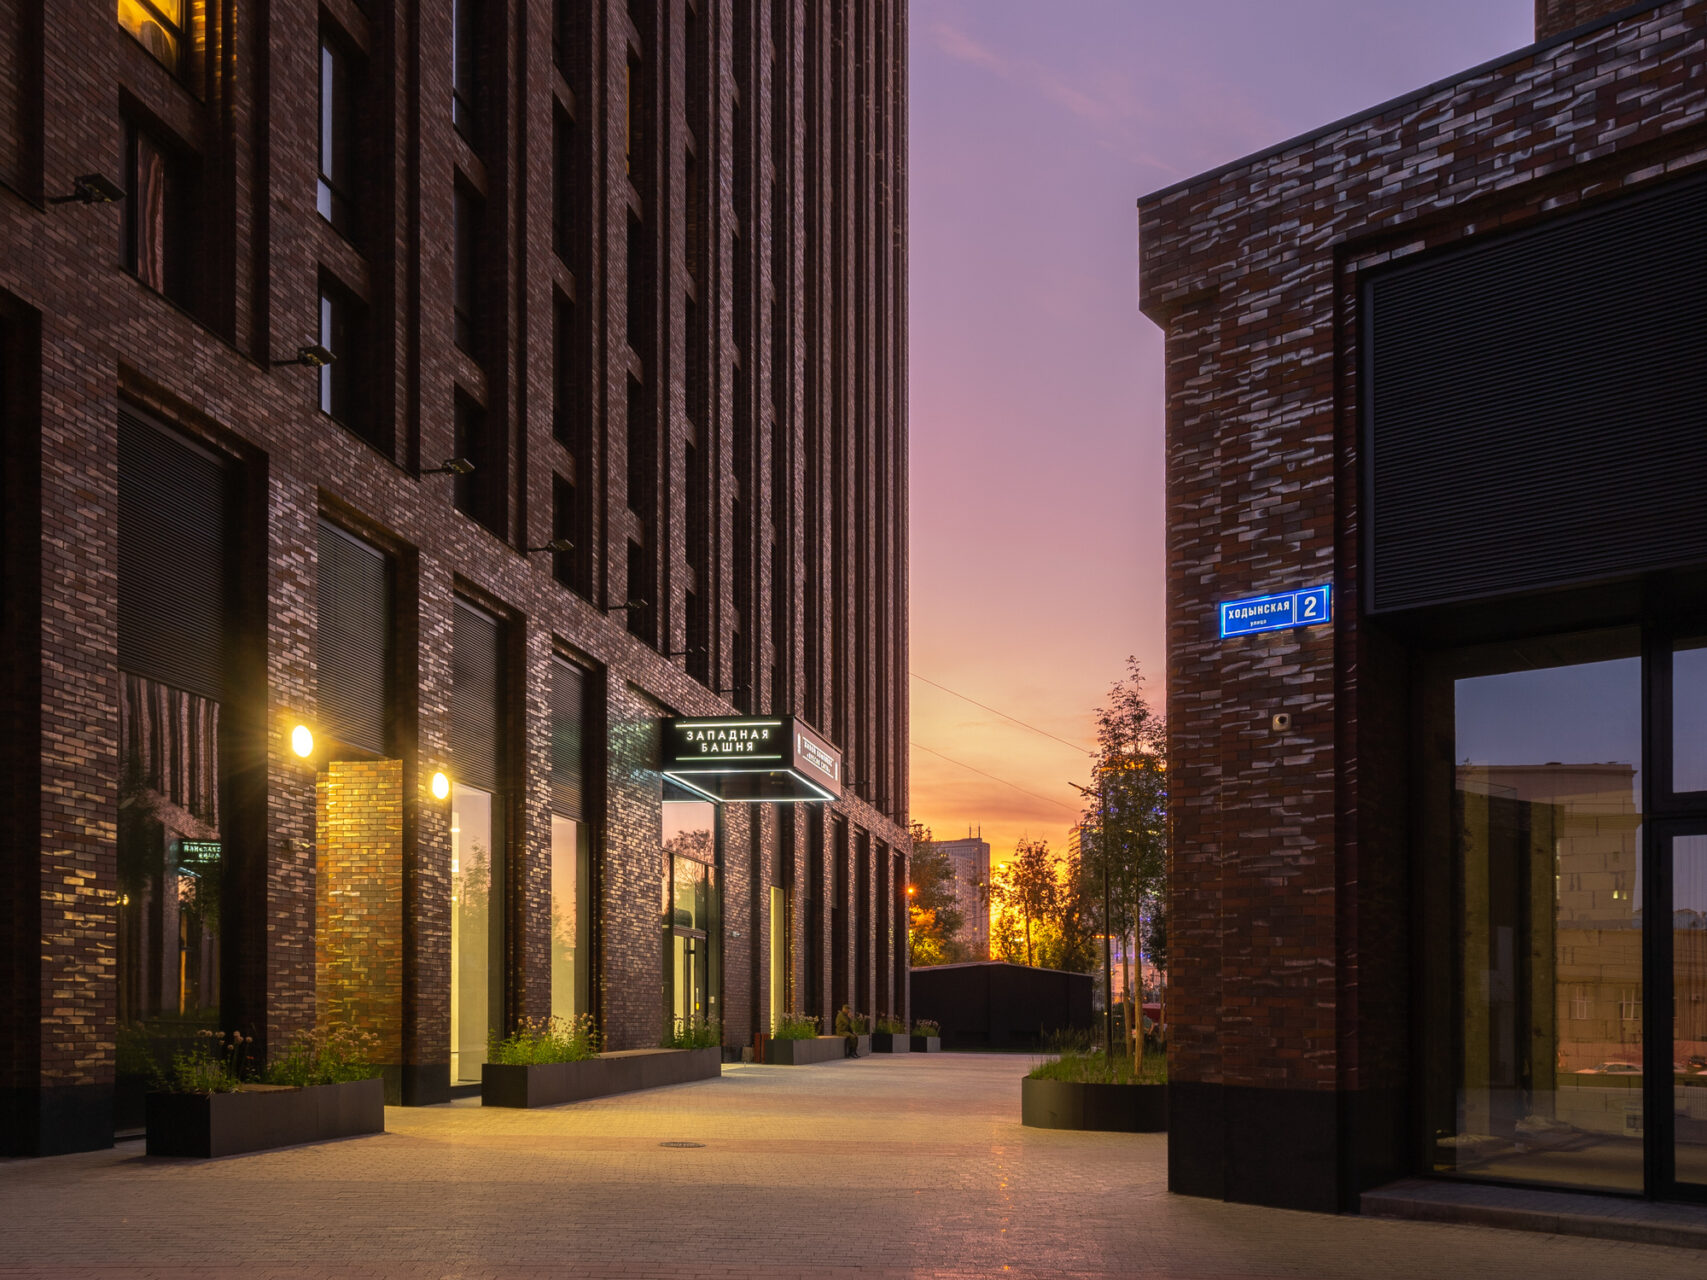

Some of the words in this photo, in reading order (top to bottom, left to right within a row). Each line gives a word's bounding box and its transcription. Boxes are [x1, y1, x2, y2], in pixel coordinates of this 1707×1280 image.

[1228, 600, 1290, 620] ХОДЫНСКАЯ
[1303, 595, 1317, 618] 2
[1249, 619, 1267, 627] улица
[686, 729, 769, 741] ЗАПАДНАЯ
[701, 741, 754, 753] БАШНЯ
